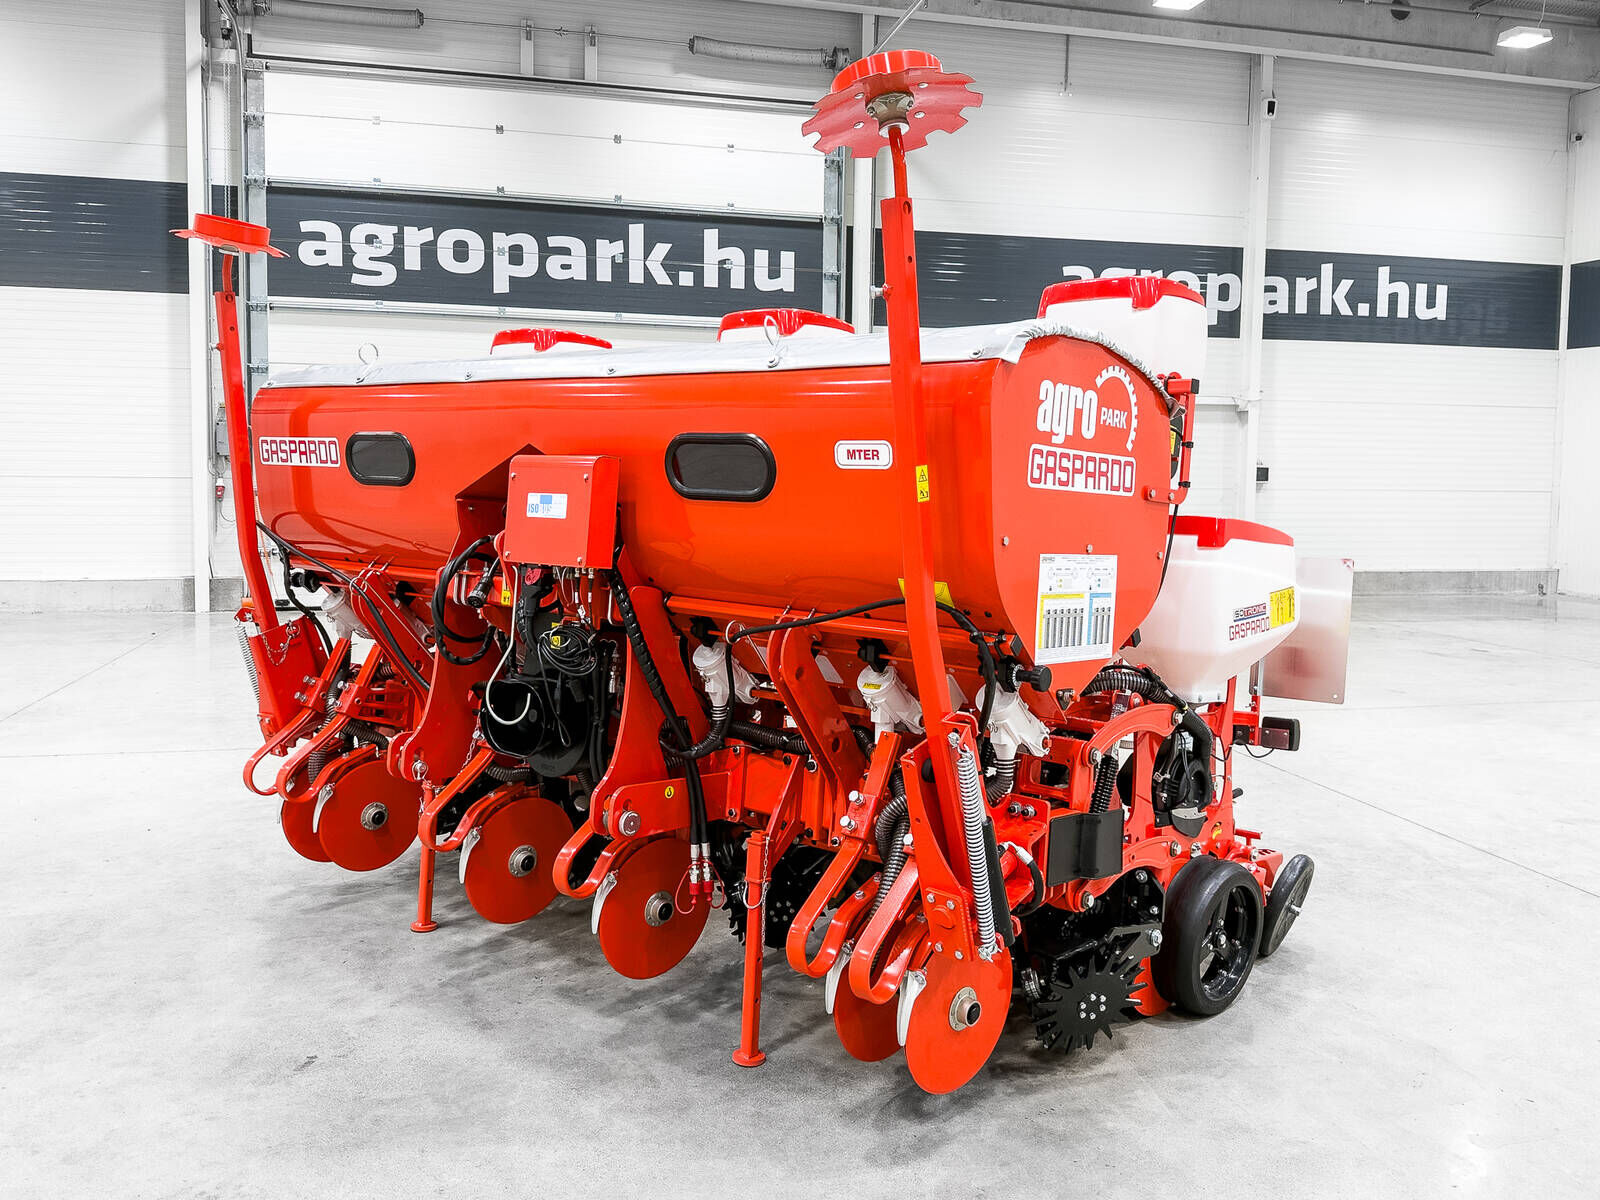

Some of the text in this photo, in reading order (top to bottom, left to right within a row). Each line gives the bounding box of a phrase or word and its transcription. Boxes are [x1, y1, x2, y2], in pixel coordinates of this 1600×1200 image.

[298, 220, 795, 293] agropark.hu
[1062, 263, 1448, 325] park.hu
[1036, 380, 1128, 444] agro PARK
[260, 439, 339, 464] GASPARDO
[846, 449, 880, 461] MTER
[1029, 448, 1134, 493] GASPARDO
[1228, 616, 1270, 641] GASPARDO
